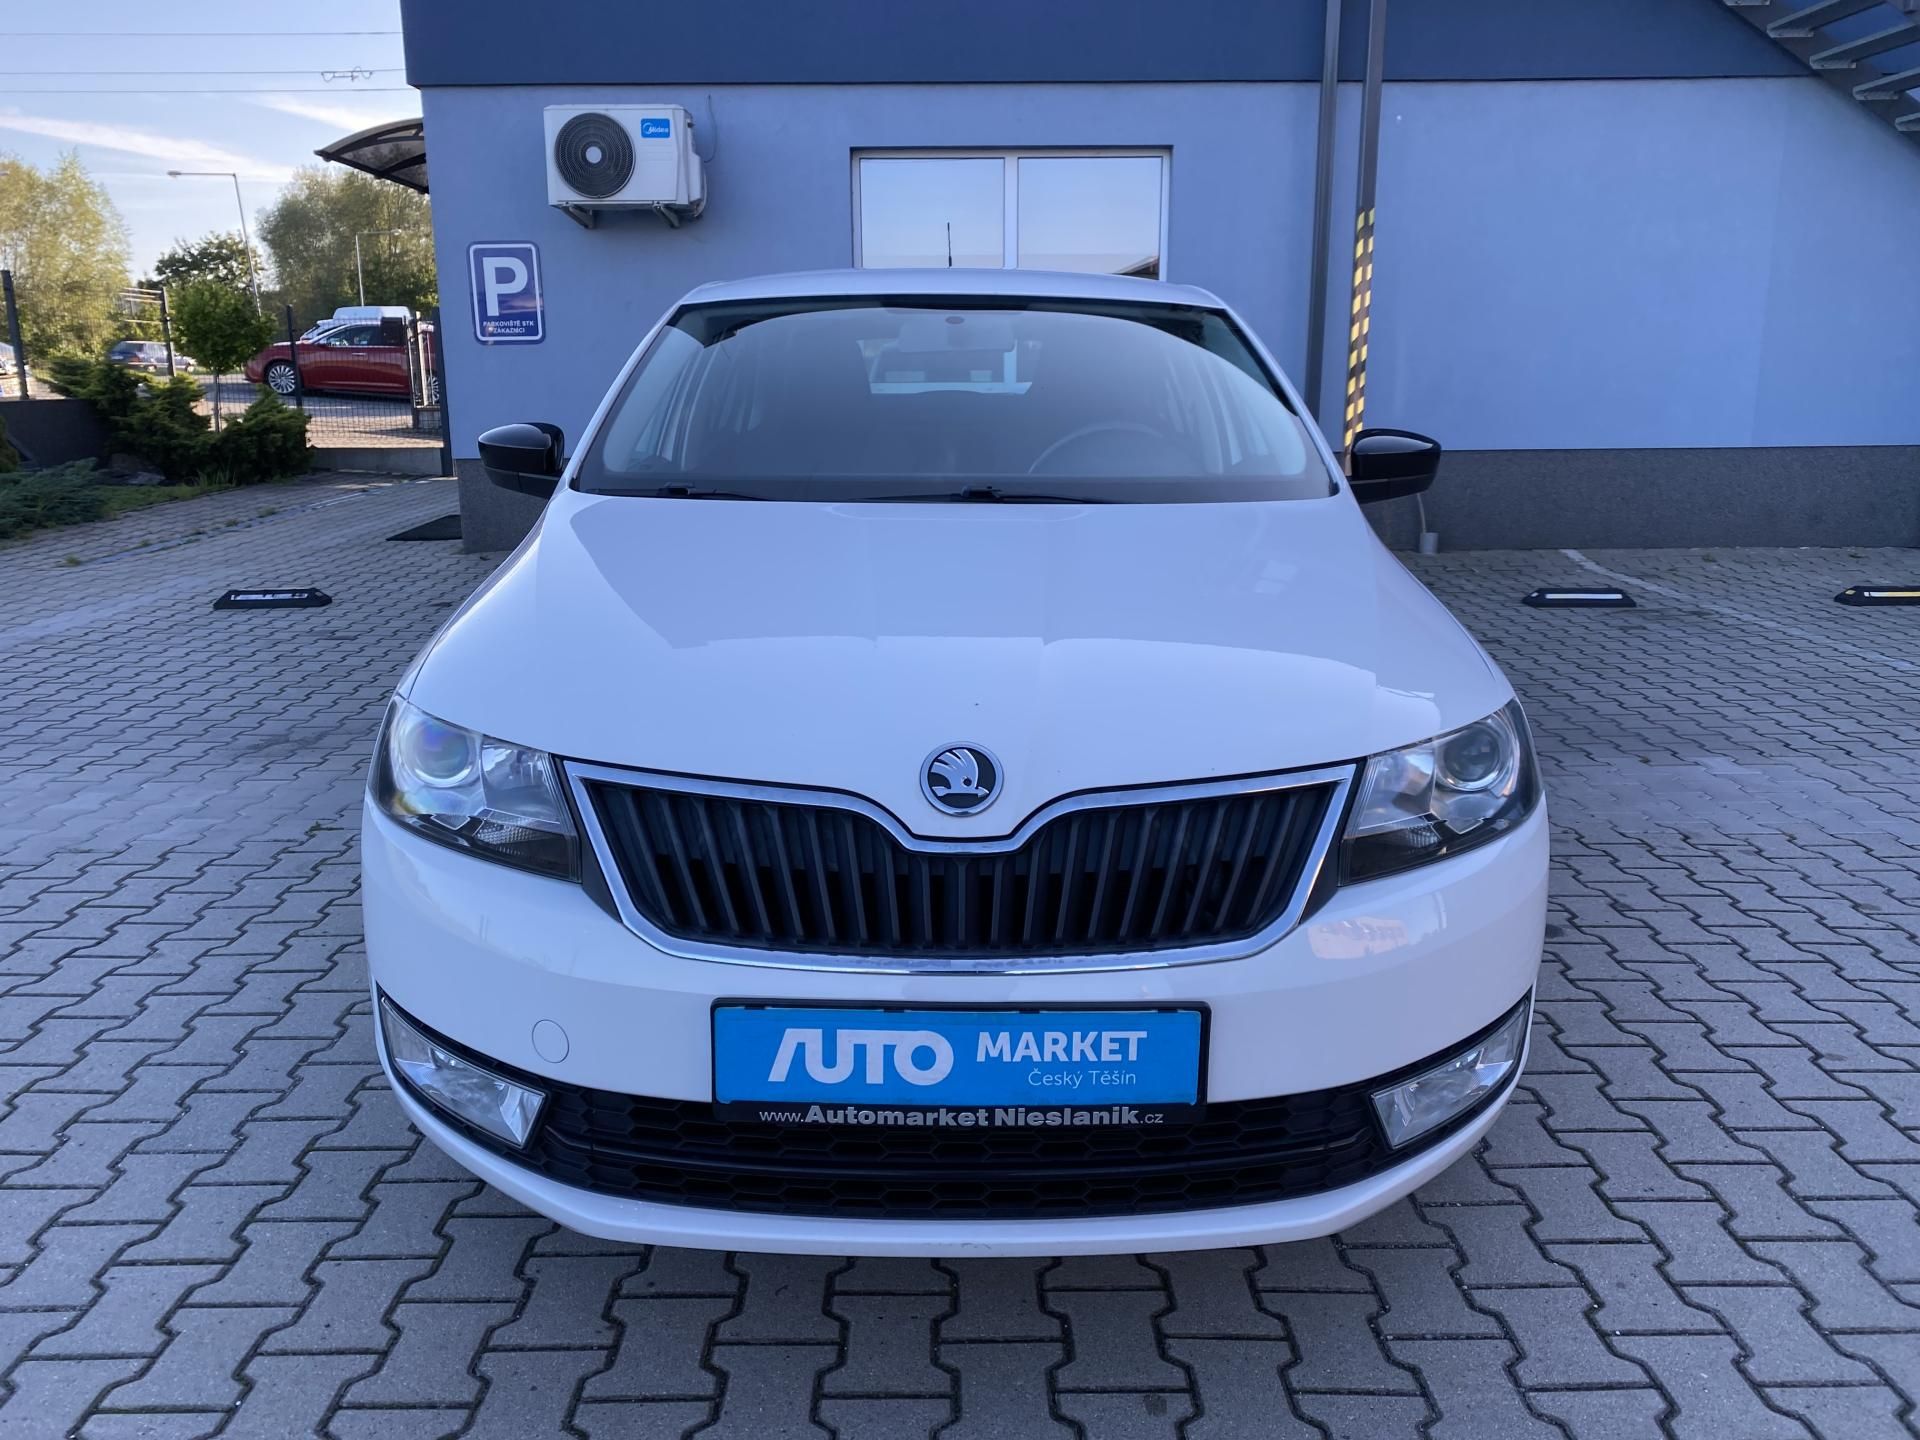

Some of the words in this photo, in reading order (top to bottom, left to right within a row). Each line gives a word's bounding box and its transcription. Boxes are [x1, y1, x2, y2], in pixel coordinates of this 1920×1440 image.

[482, 256, 528, 317] P
[767, 1027, 955, 1087] AUTO
[976, 1030, 1148, 1063] MARKET
[1028, 1067, 1084, 1089] Český
[1088, 1068, 1137, 1086] Těšín
